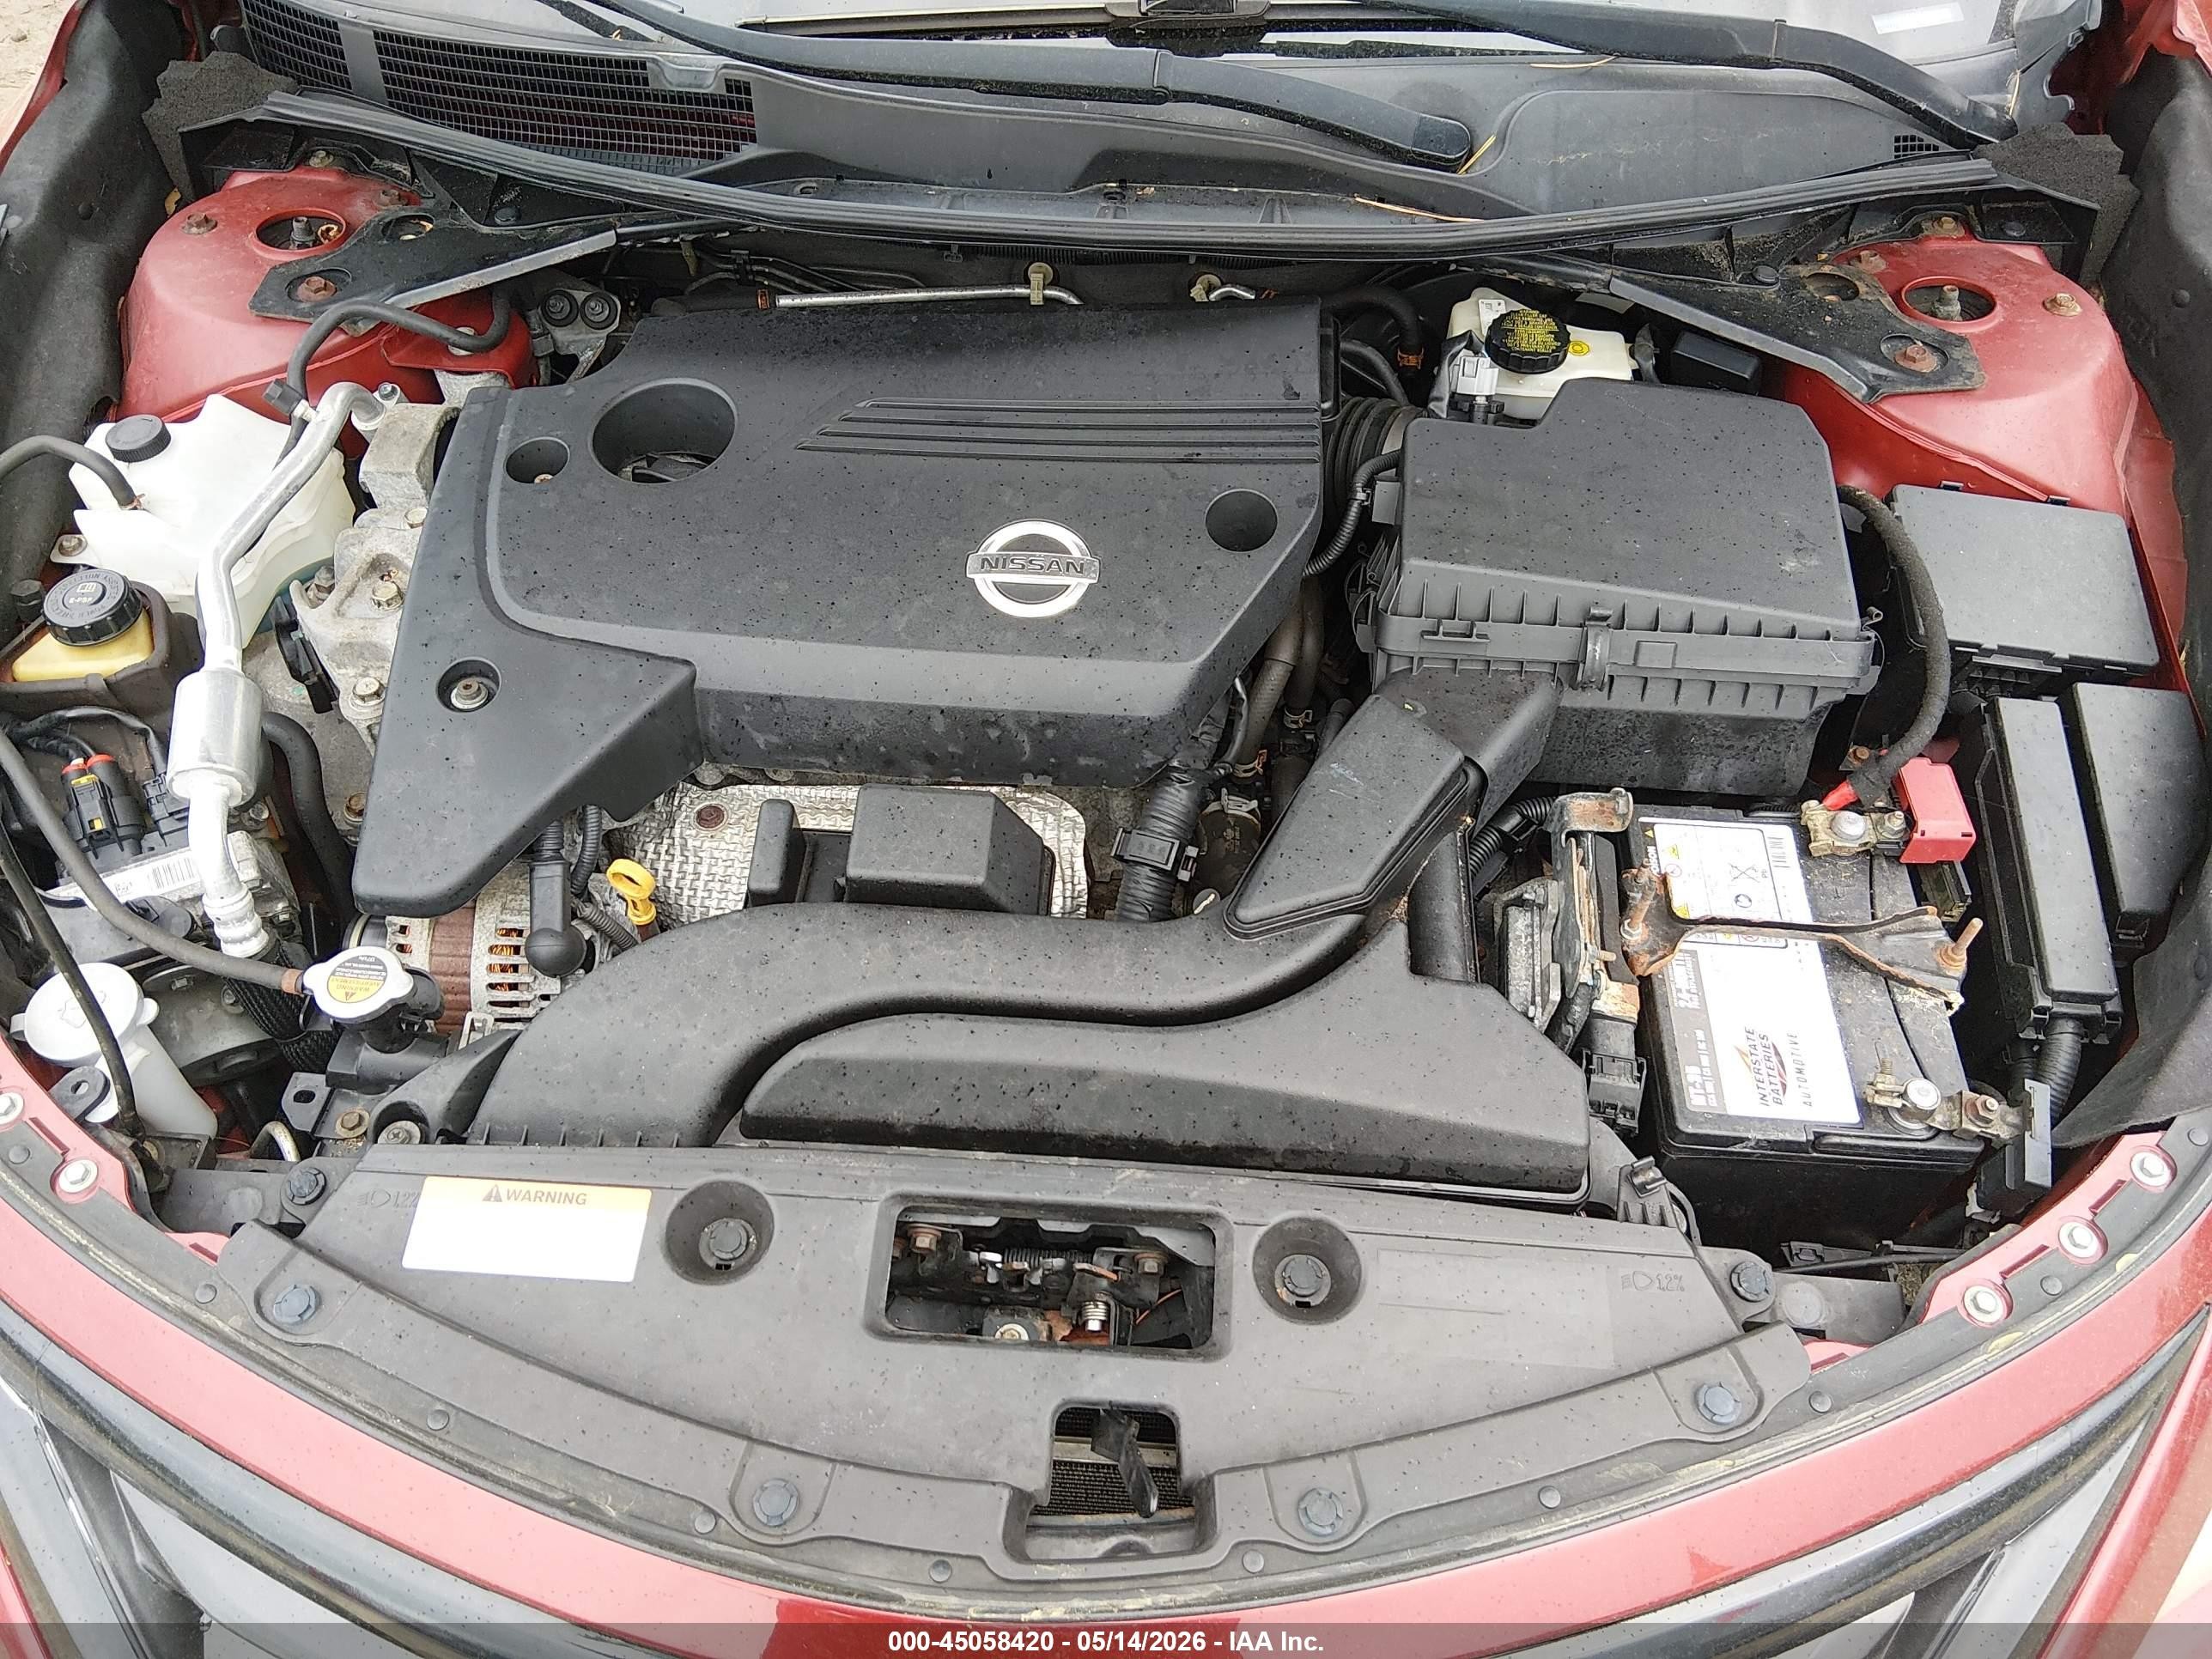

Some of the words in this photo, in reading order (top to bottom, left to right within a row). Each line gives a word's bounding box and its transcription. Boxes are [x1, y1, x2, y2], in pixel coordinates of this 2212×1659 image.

[980, 557, 1085, 574] NISSAN
[1744, 1025, 1770, 1107] INTERSTATE
[1759, 1033, 1784, 1106] BATTERIES
[1786, 1032, 1814, 1107] AUTOMOTIVE
[506, 1188, 587, 1206] WARNING
